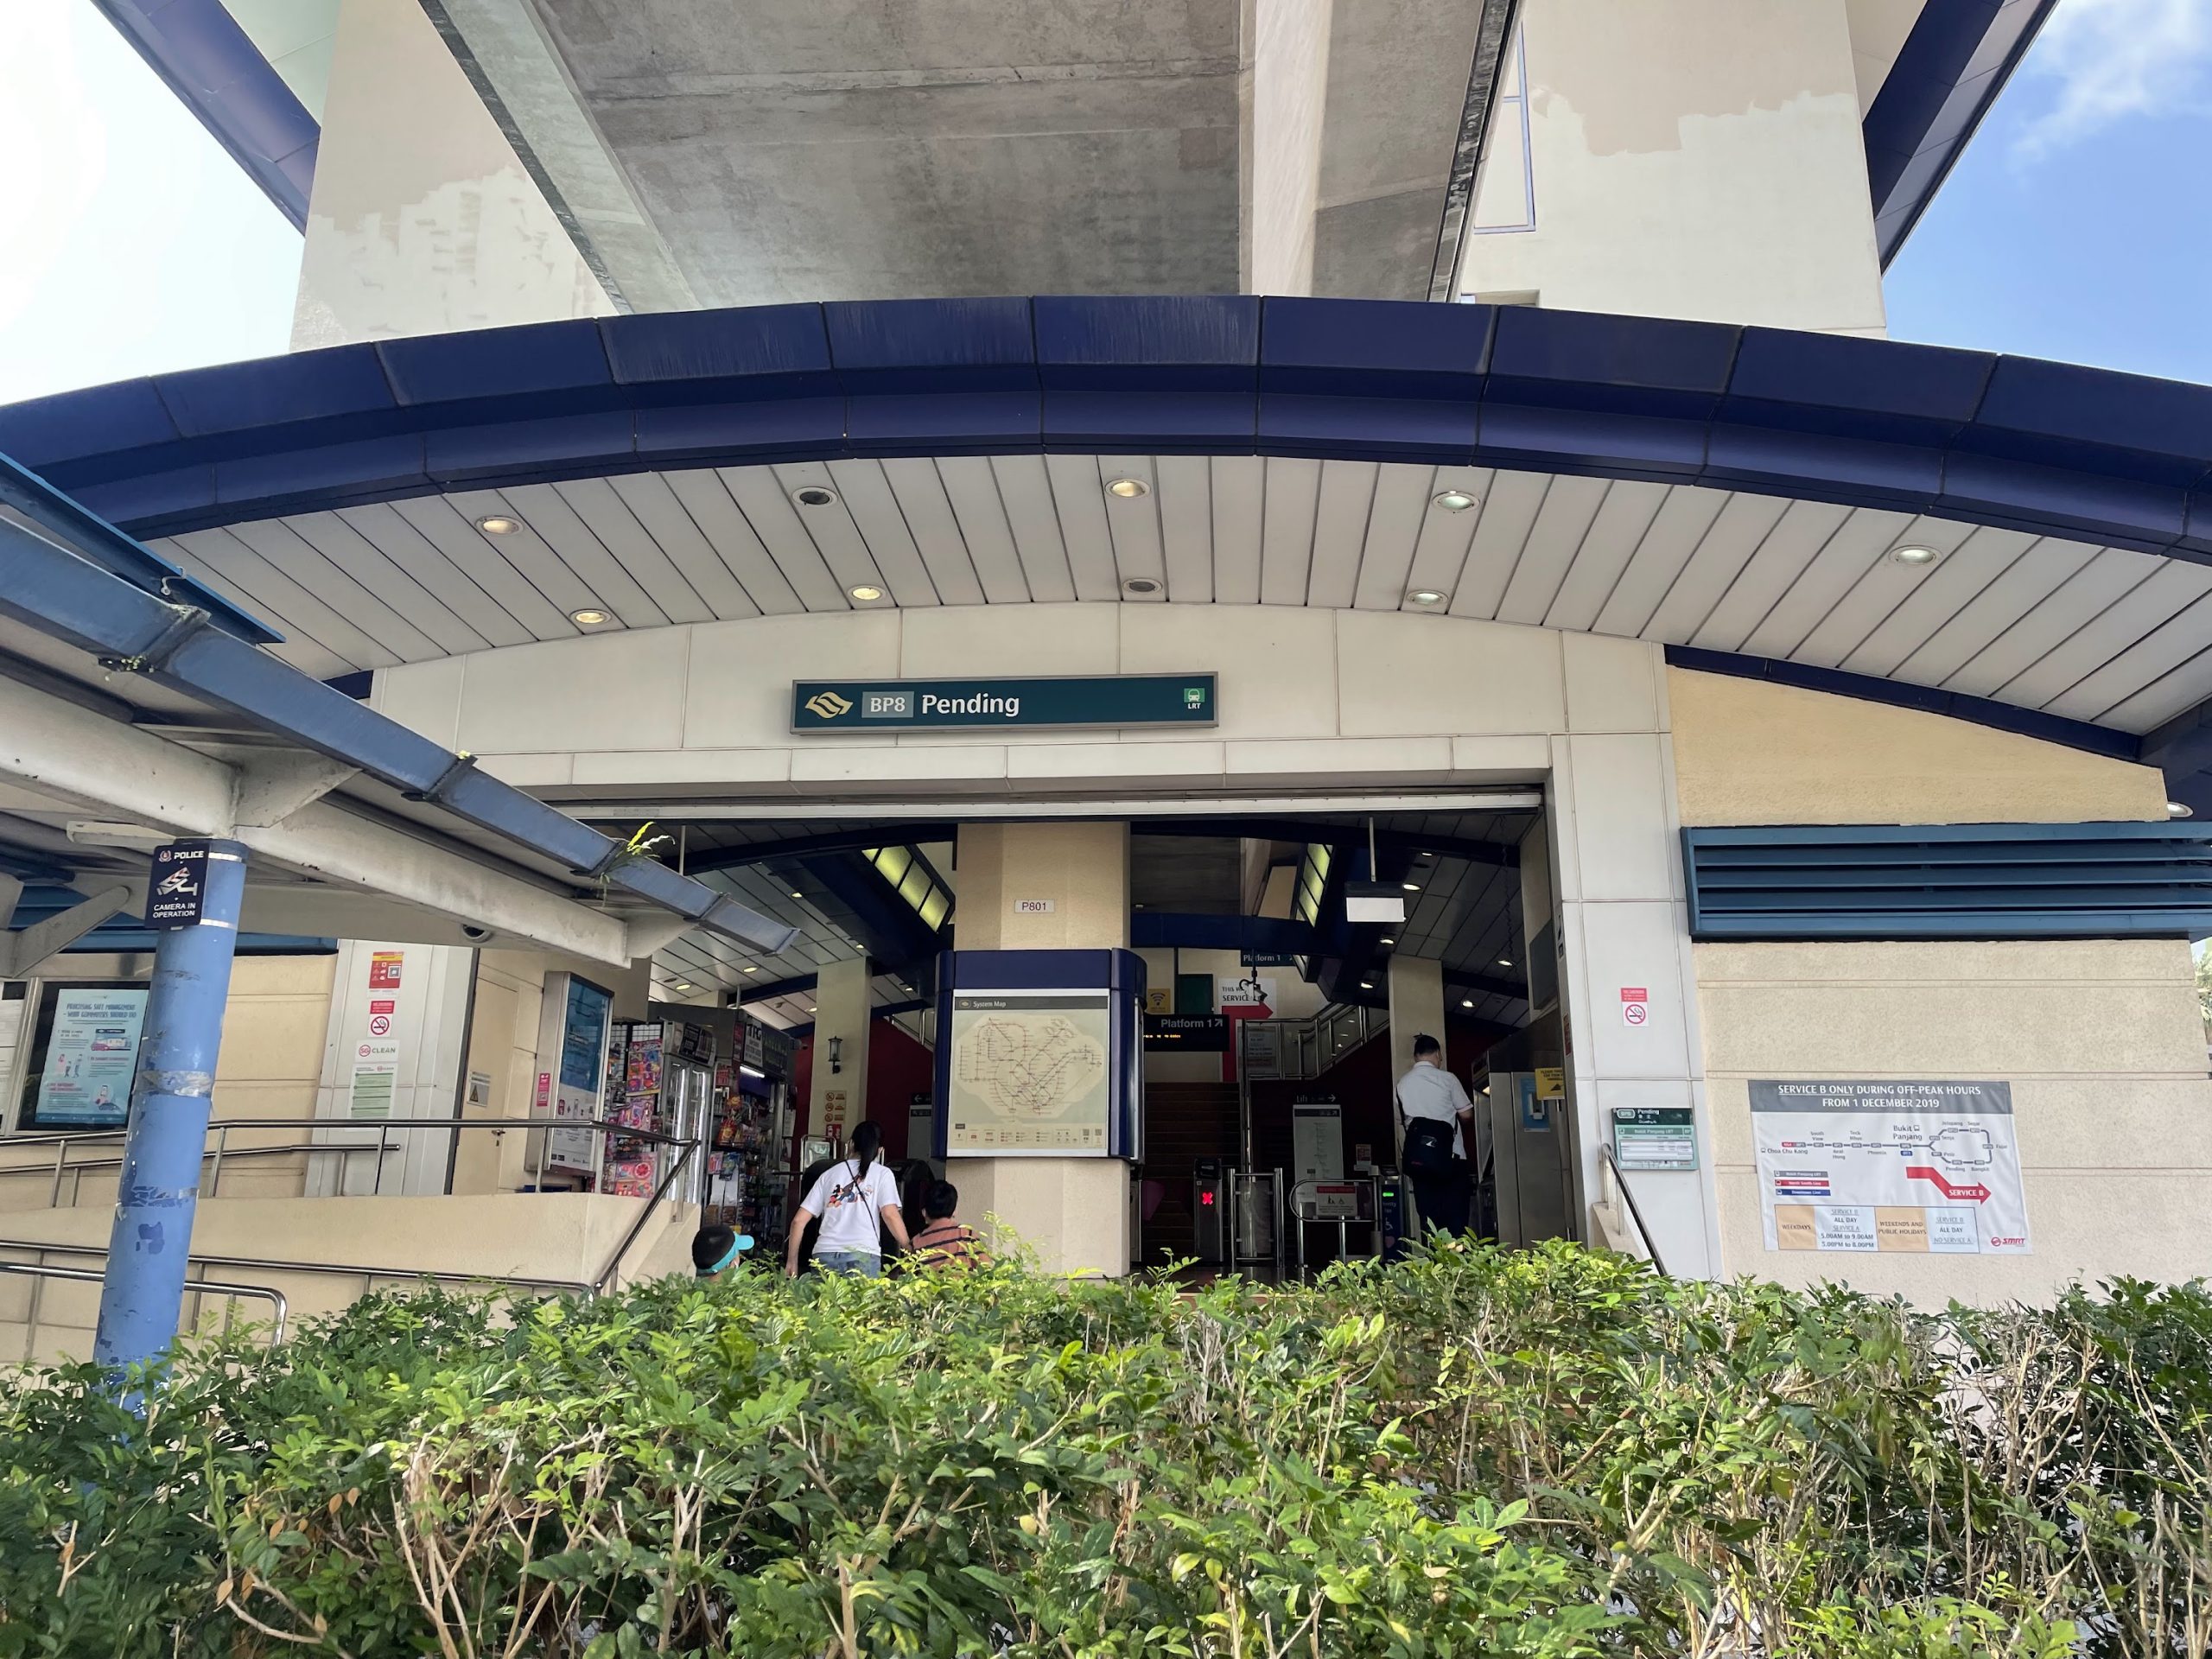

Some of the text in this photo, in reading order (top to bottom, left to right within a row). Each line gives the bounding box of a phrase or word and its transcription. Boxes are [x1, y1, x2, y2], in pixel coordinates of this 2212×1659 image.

[869, 693, 1020, 717] BP8 Pending
[174, 851, 204, 860] POLICE
[1021, 902, 1046, 911] P801
[1161, 1019, 1212, 1028] Platform 1
[1778, 1085, 1981, 1095] SERVICE B ONLY DURING OFF-PEAK HOURS
[1862, 1099, 1913, 1108] DECEMBER
[1916, 1099, 1940, 1108] 2019
